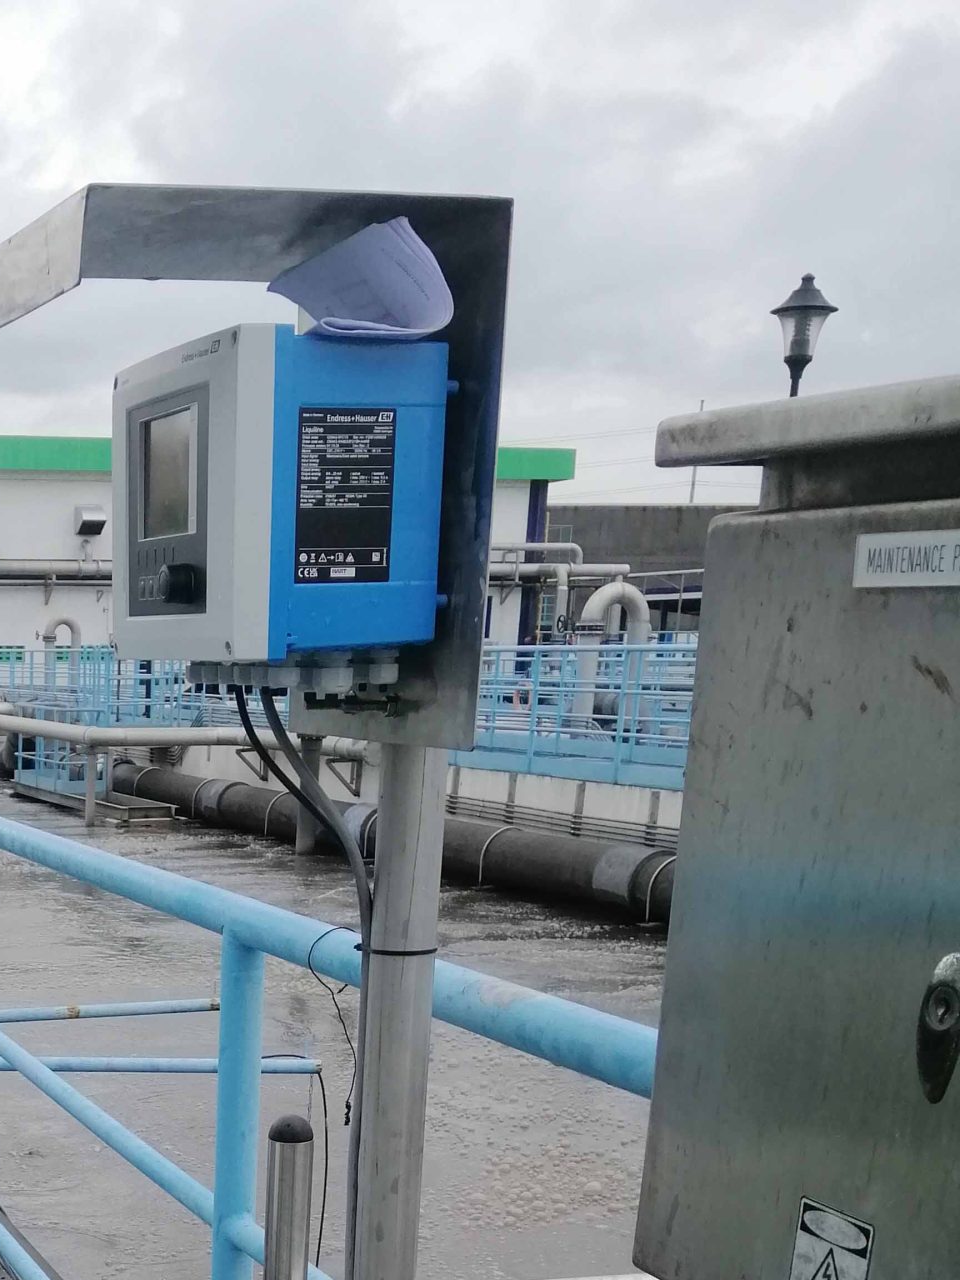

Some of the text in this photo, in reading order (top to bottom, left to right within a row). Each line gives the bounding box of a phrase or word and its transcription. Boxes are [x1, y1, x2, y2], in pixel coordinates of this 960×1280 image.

[326, 414, 377, 422] Endress+Hauser
[867, 544, 960, 573] MAINTENANCE P
